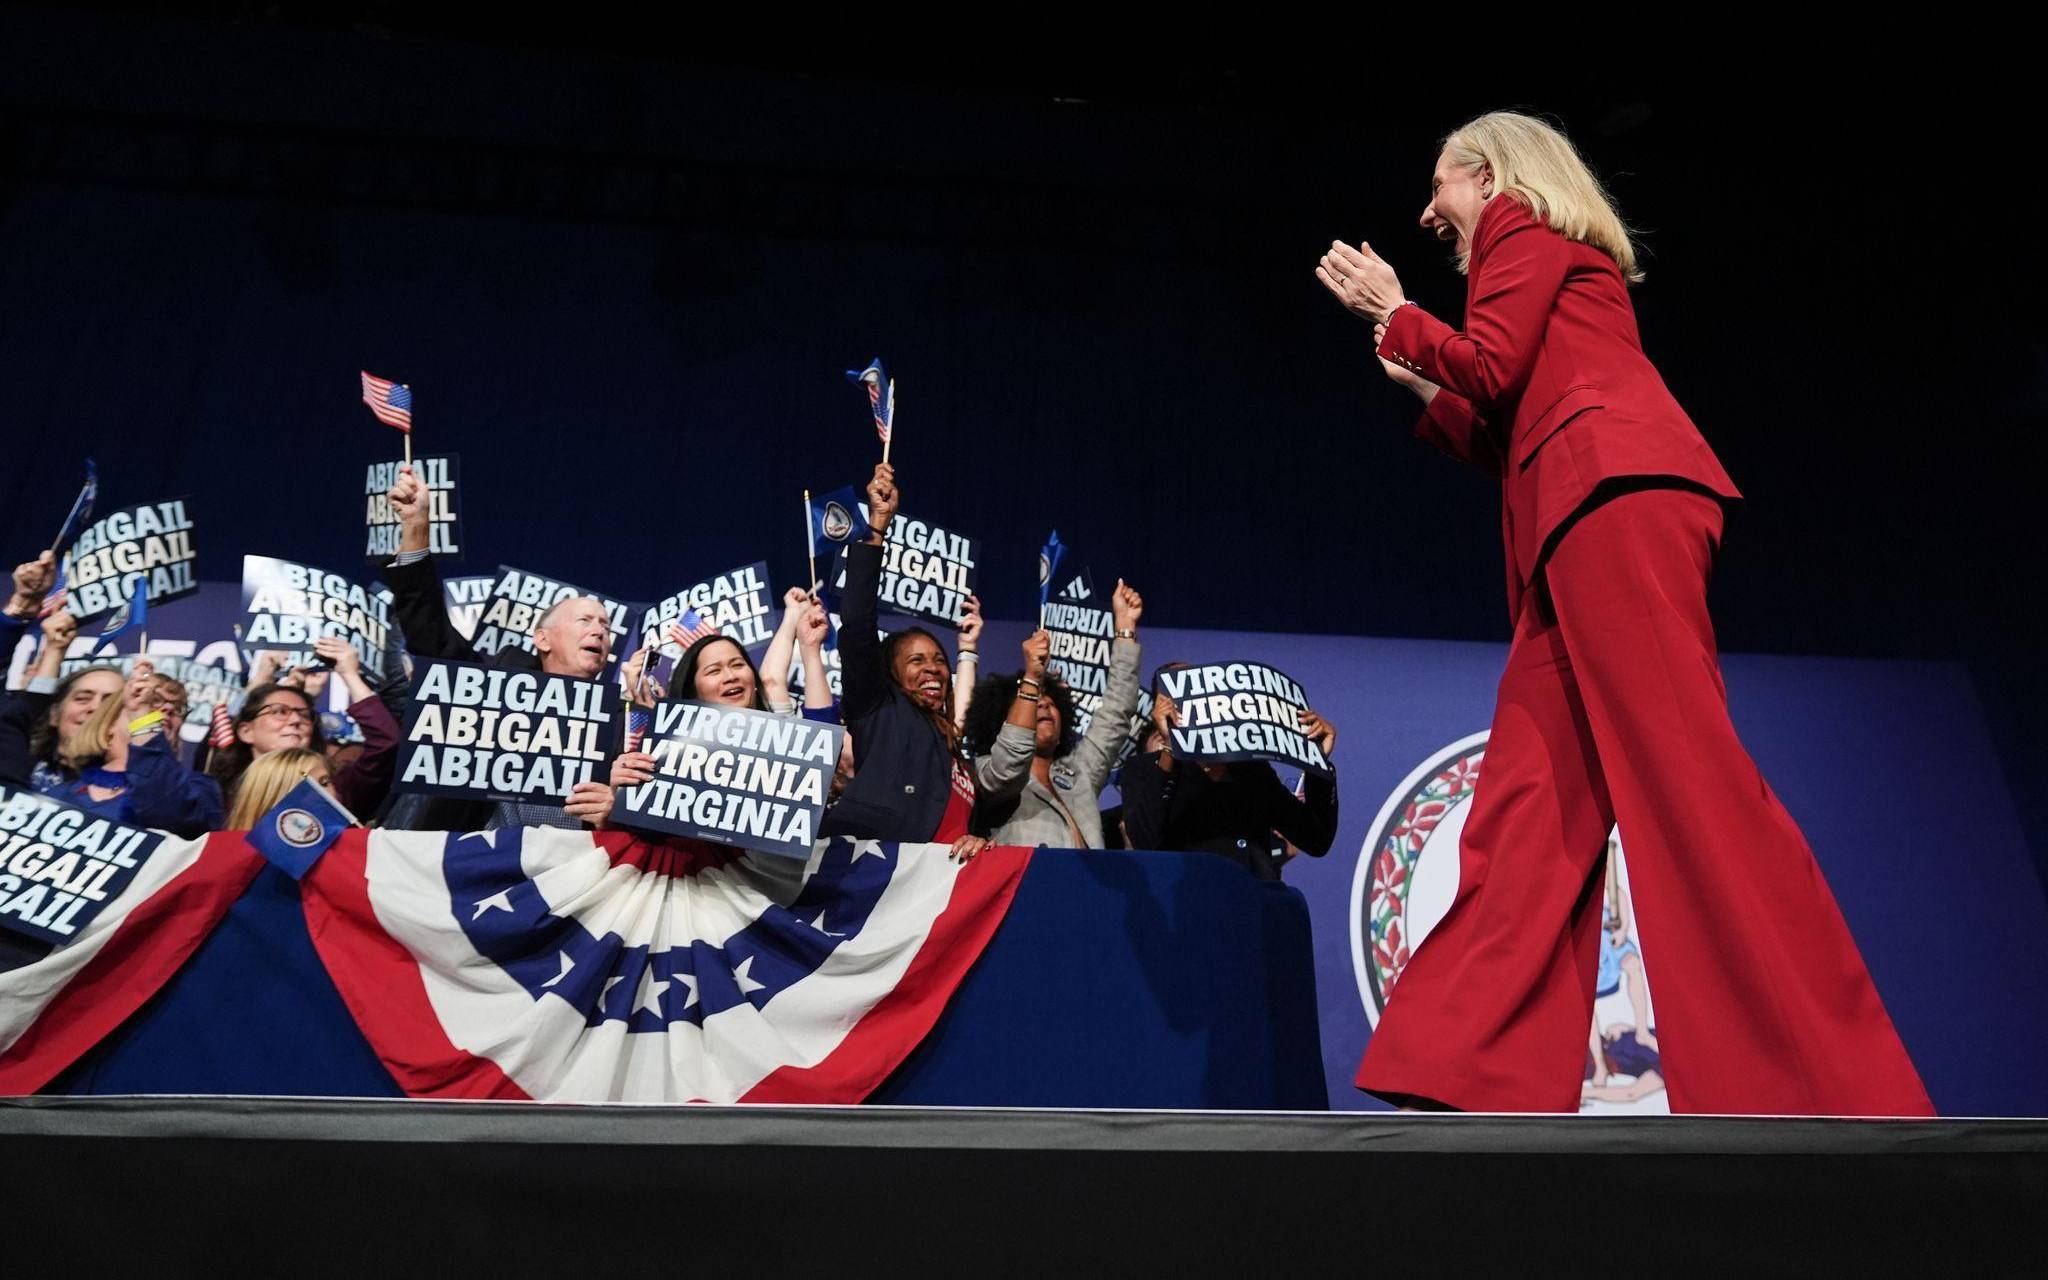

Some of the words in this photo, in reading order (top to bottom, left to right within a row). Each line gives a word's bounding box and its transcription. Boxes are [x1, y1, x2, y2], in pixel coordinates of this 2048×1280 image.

[641, 567, 765, 634] ABIGAIL
[415, 663, 611, 723] ABIGAIL
[1160, 663, 1310, 710] VIRGINIA
[408, 703, 606, 761] ABIGAIL
[653, 702, 834, 766] VIRGINIA
[1171, 721, 1328, 771] VIRGINIA
[0, 785, 148, 869] BIGAIL
[626, 778, 812, 847] VIRGINIA
[0, 831, 119, 902] IGAIL
